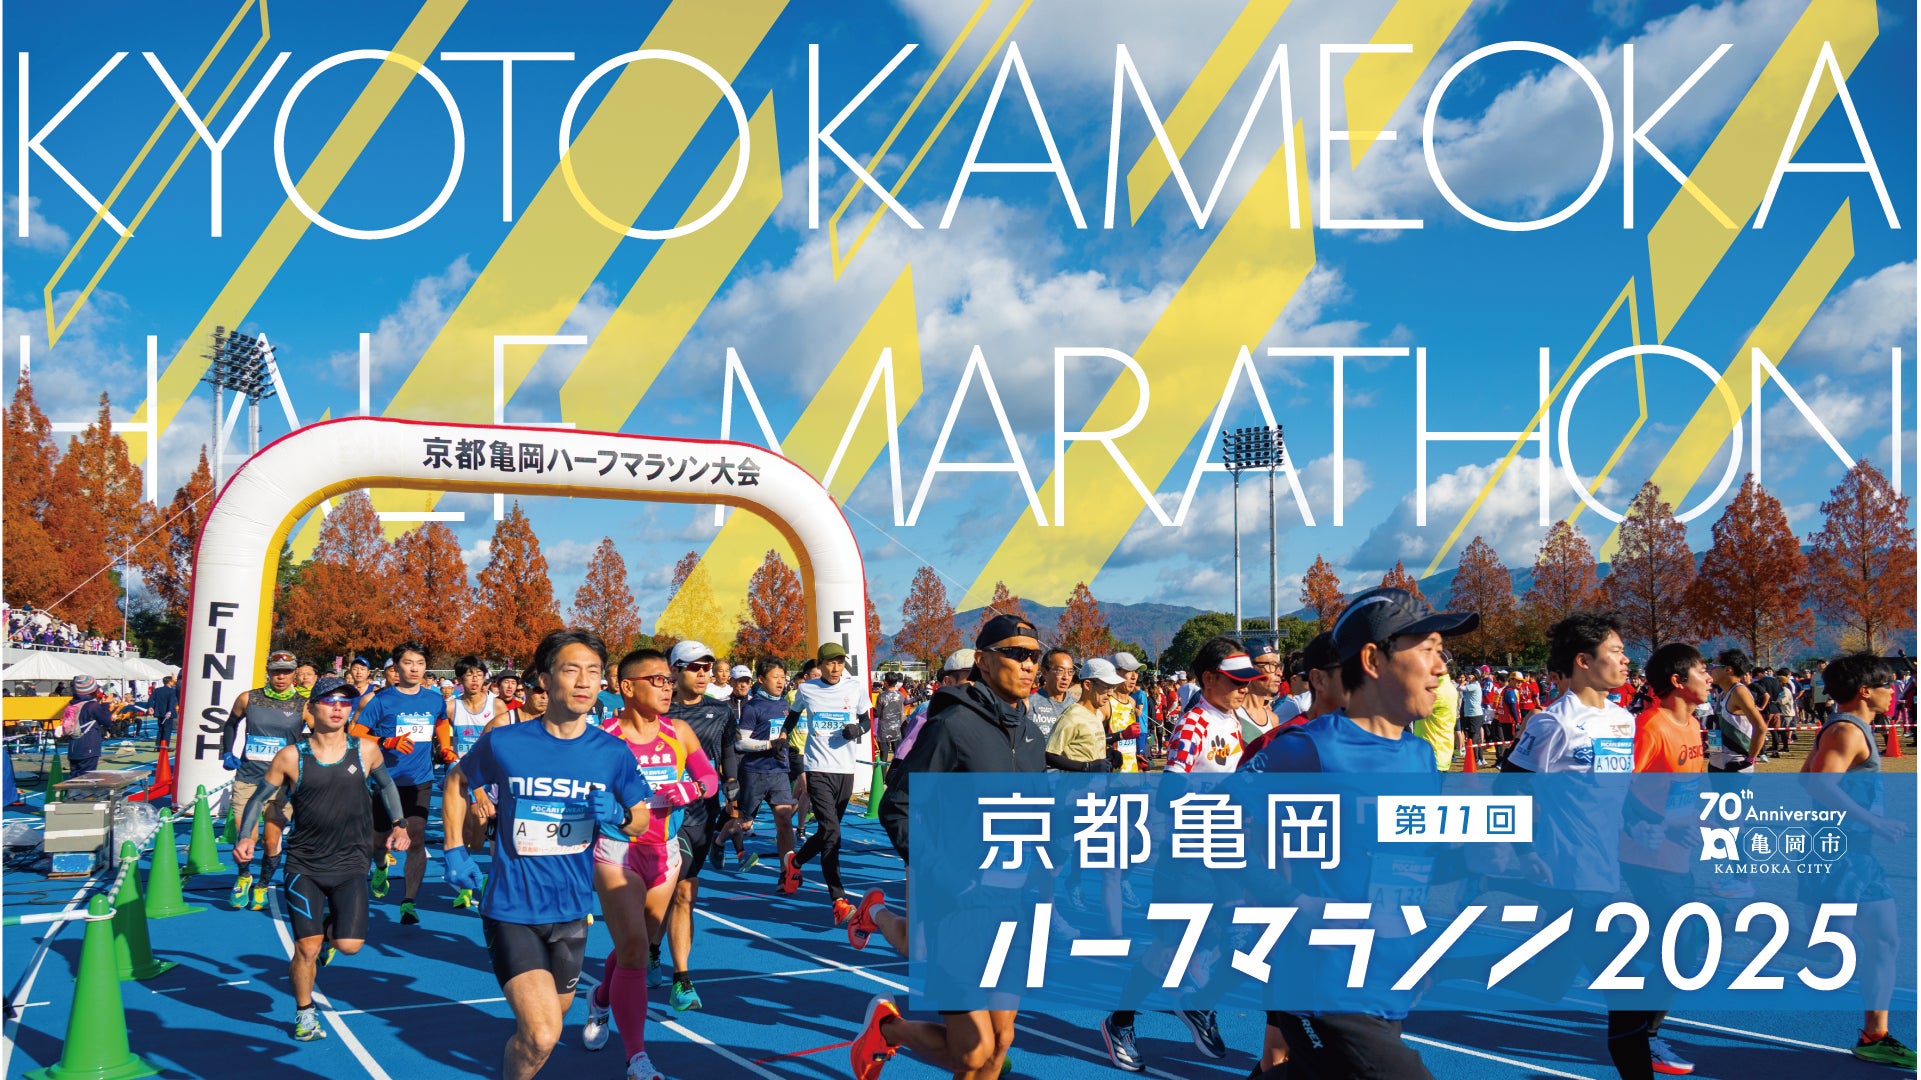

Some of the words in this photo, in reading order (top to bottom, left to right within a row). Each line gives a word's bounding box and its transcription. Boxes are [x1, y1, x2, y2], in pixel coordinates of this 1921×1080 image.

[423, 437, 761, 486] 京都亀岡ハーフマラソン大会
[194, 601, 239, 760] FINISH
[1033, 713, 1057, 725] Move
[516, 821, 527, 837] A
[546, 823, 571, 838] 90
